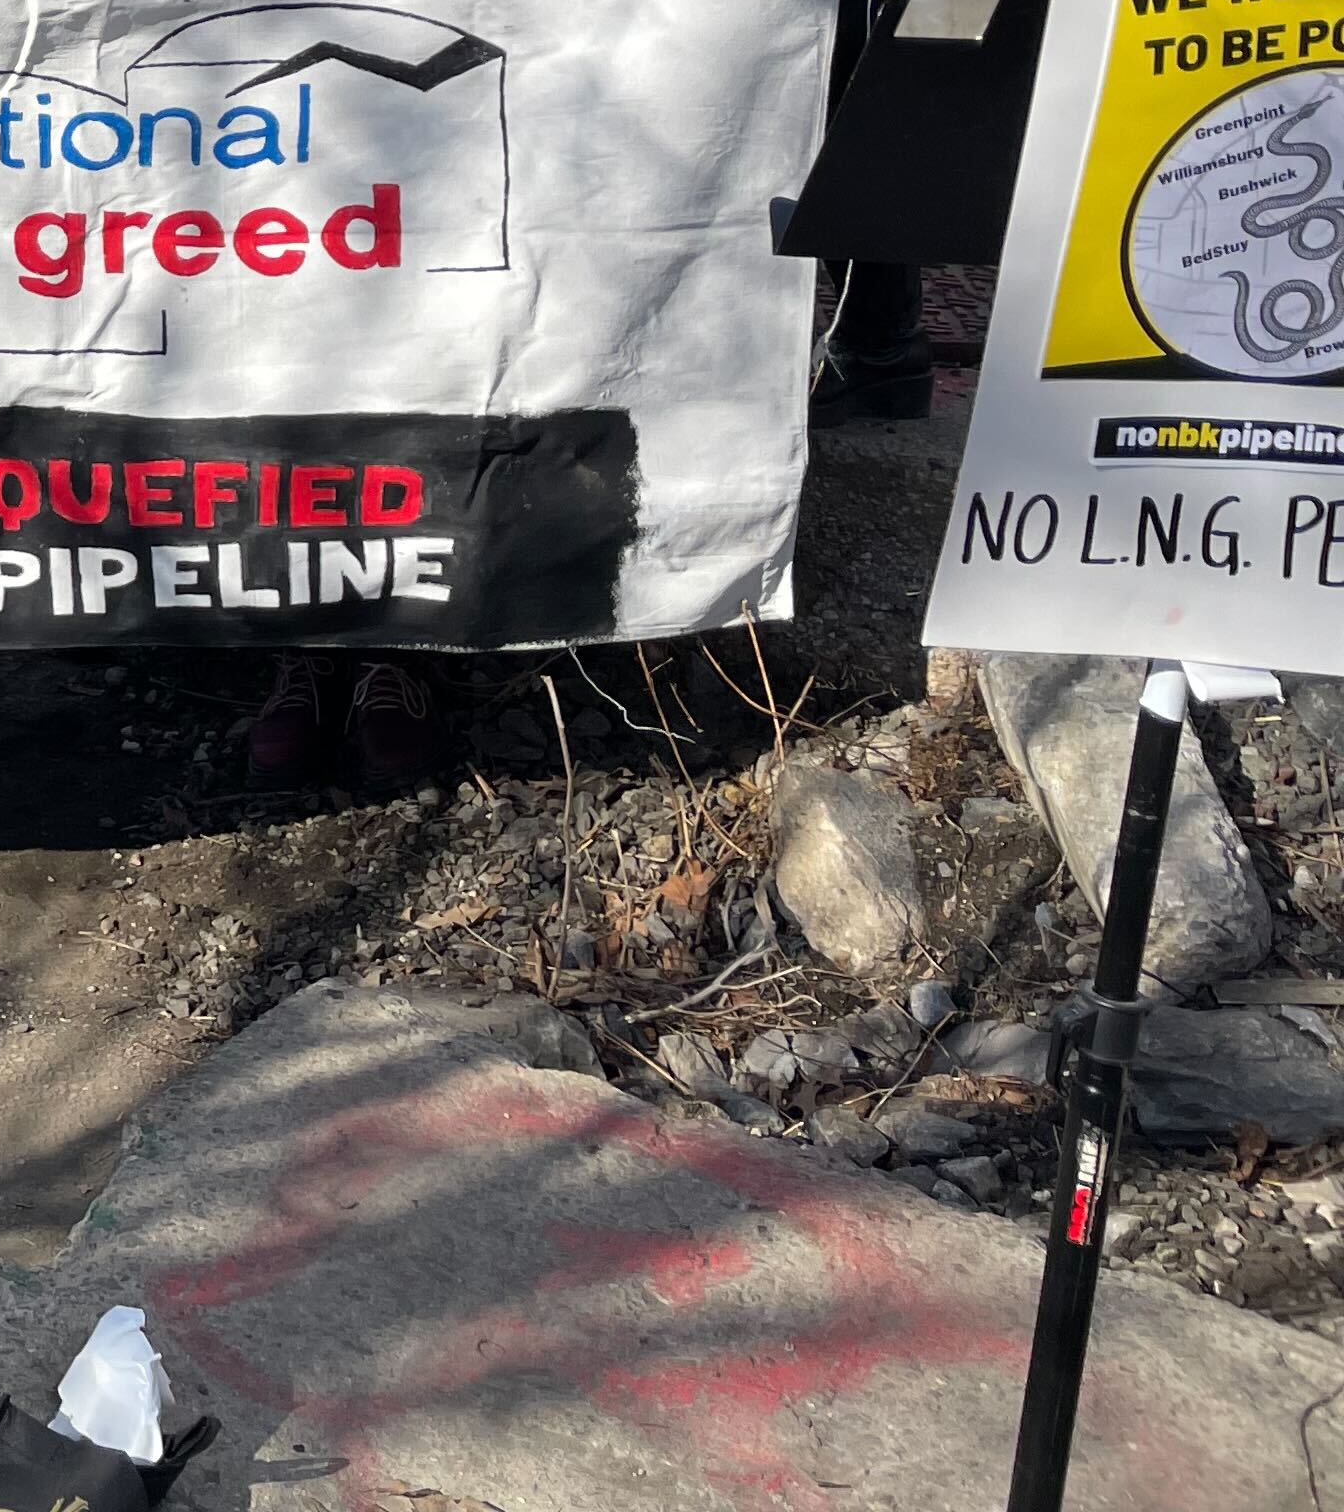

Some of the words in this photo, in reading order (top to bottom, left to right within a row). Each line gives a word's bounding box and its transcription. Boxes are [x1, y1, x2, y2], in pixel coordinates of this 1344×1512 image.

[1143, 33, 1209, 76] TO
[1221, 23, 1287, 68] BE
[1194, 104, 1286, 140] Greenpoint
[1157, 145, 1264, 186] Williamsburg
[1218, 167, 1298, 201] Bushwick
[13, 182, 402, 299] greed
[1182, 239, 1250, 269] BedStuy
[961, 491, 1059, 565] NO
[1080, 492, 1252, 576] L.N.G.
